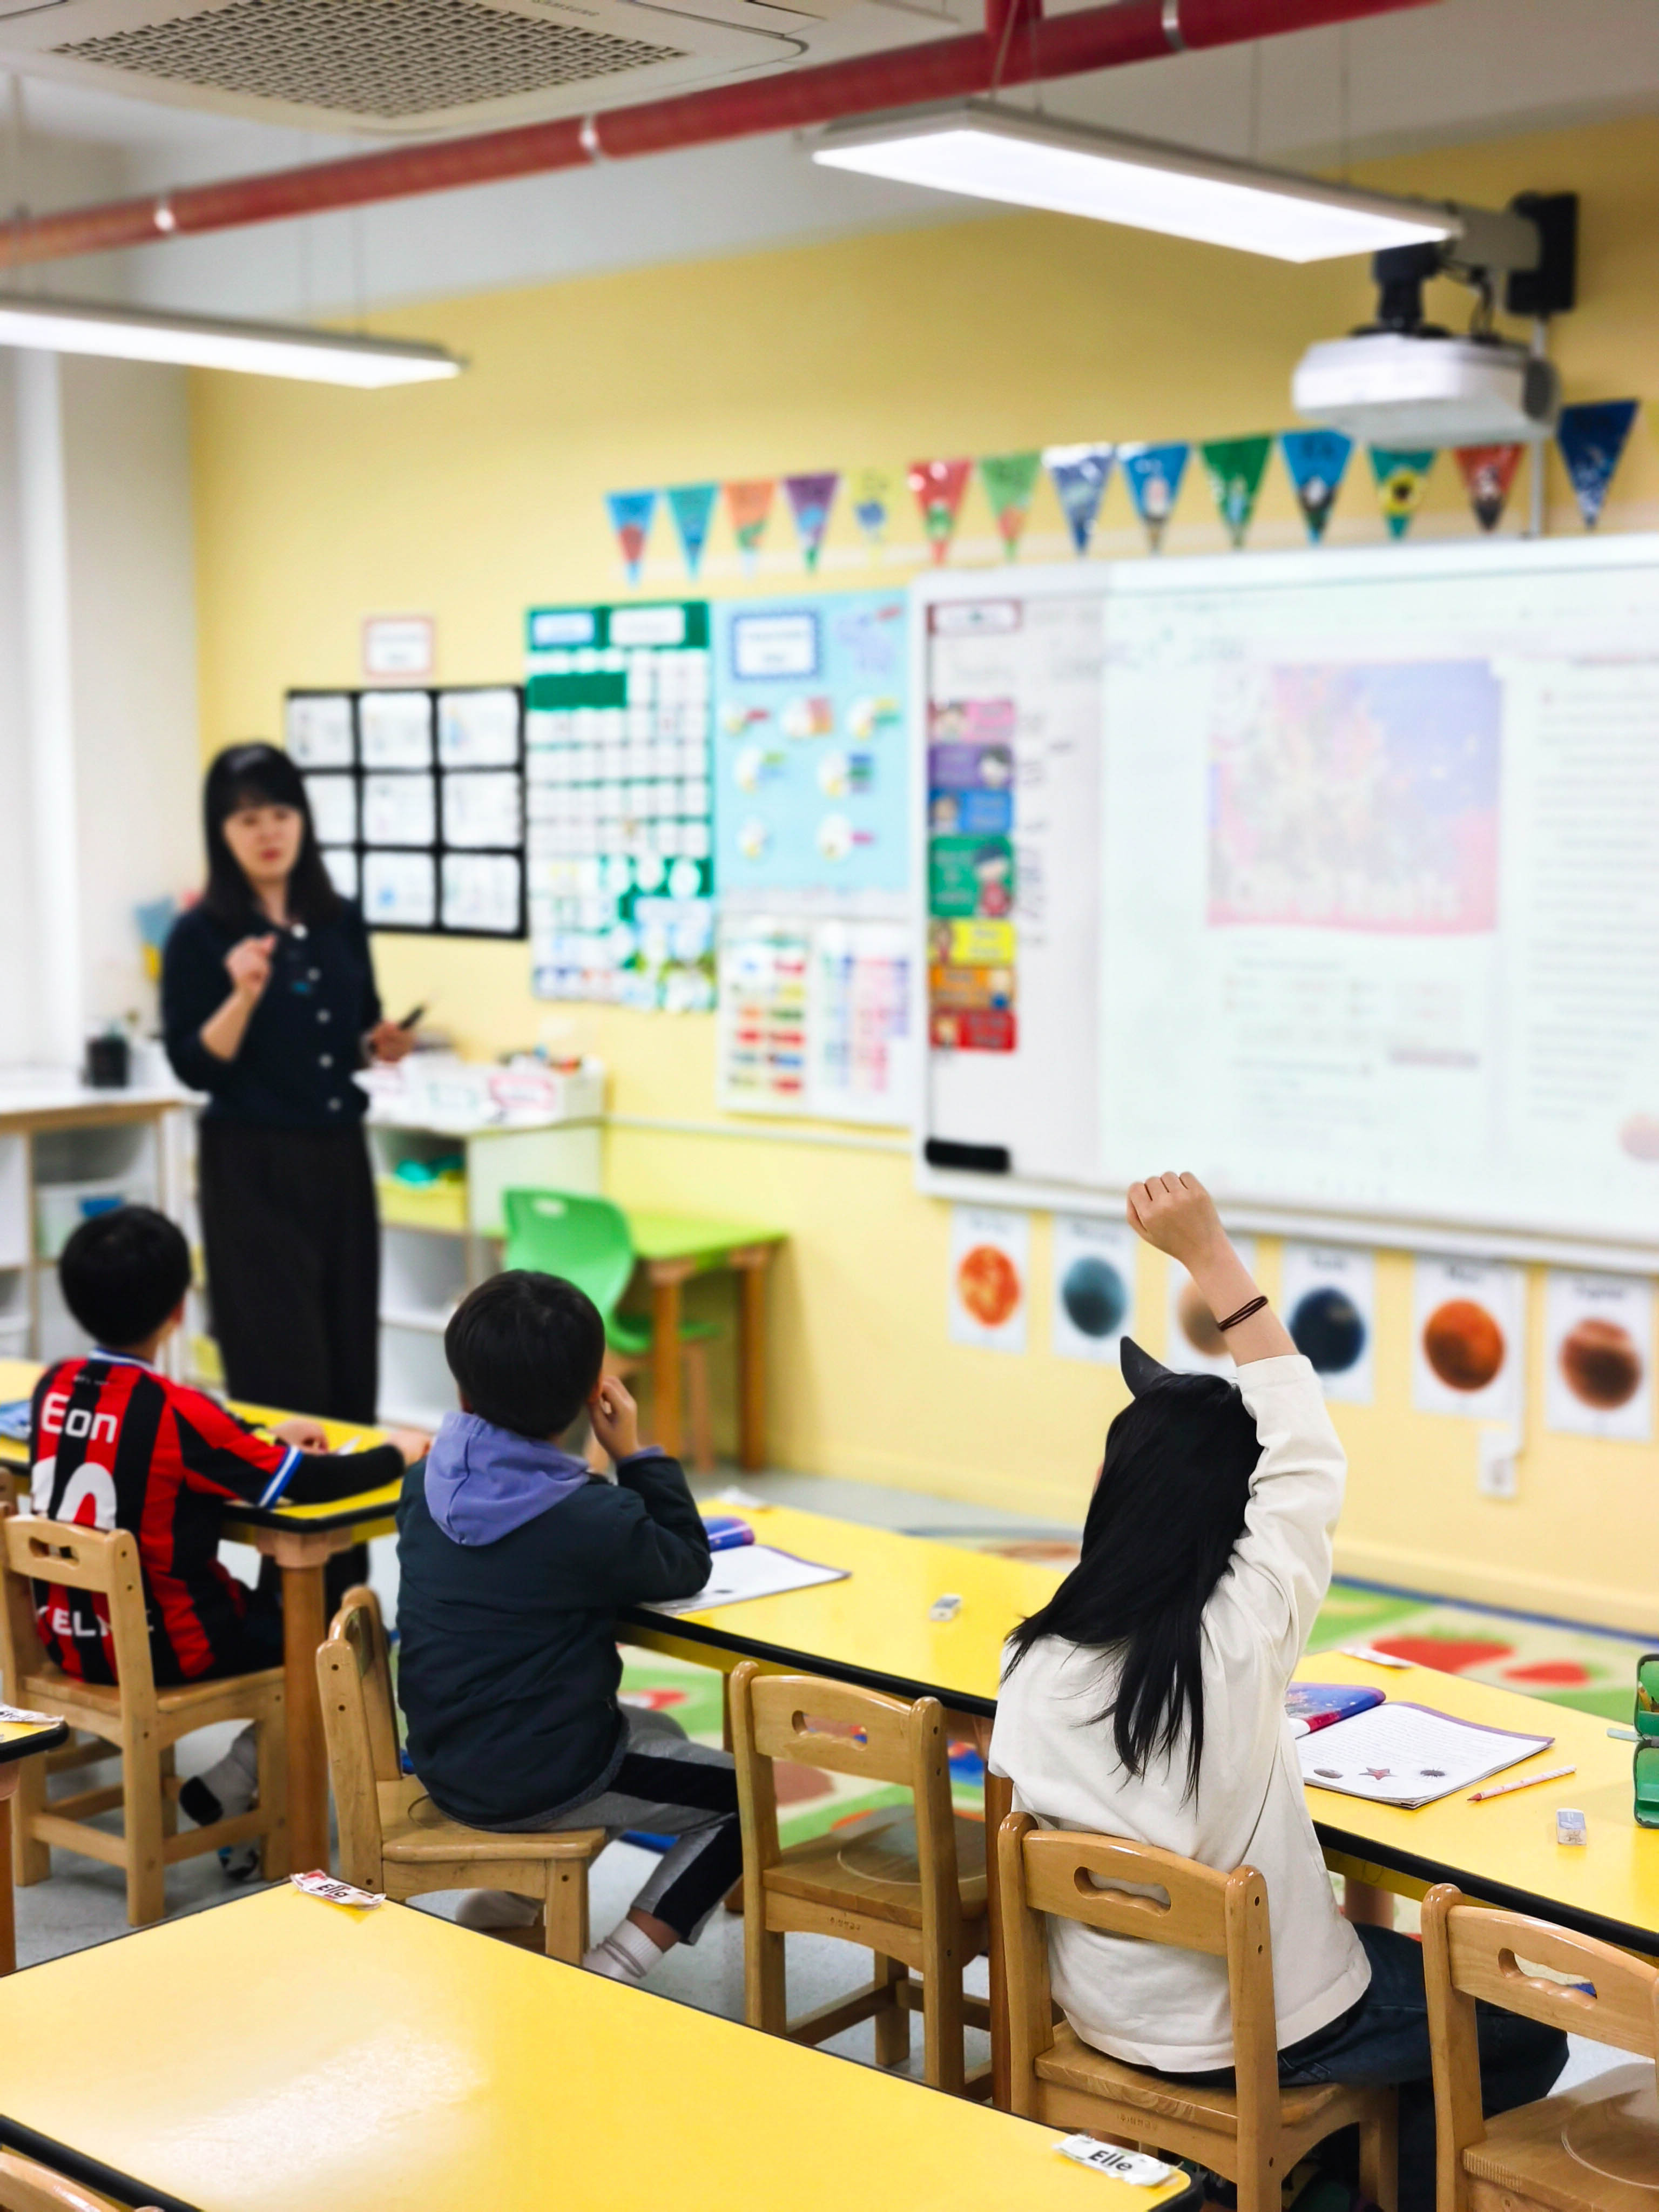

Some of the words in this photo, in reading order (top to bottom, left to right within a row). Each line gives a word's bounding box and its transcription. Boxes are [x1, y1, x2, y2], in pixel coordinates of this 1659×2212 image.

[42, 1392, 118, 1444] Eon
[316, 1883, 350, 1898] Ella
[1088, 2150, 1134, 2171] Elle
